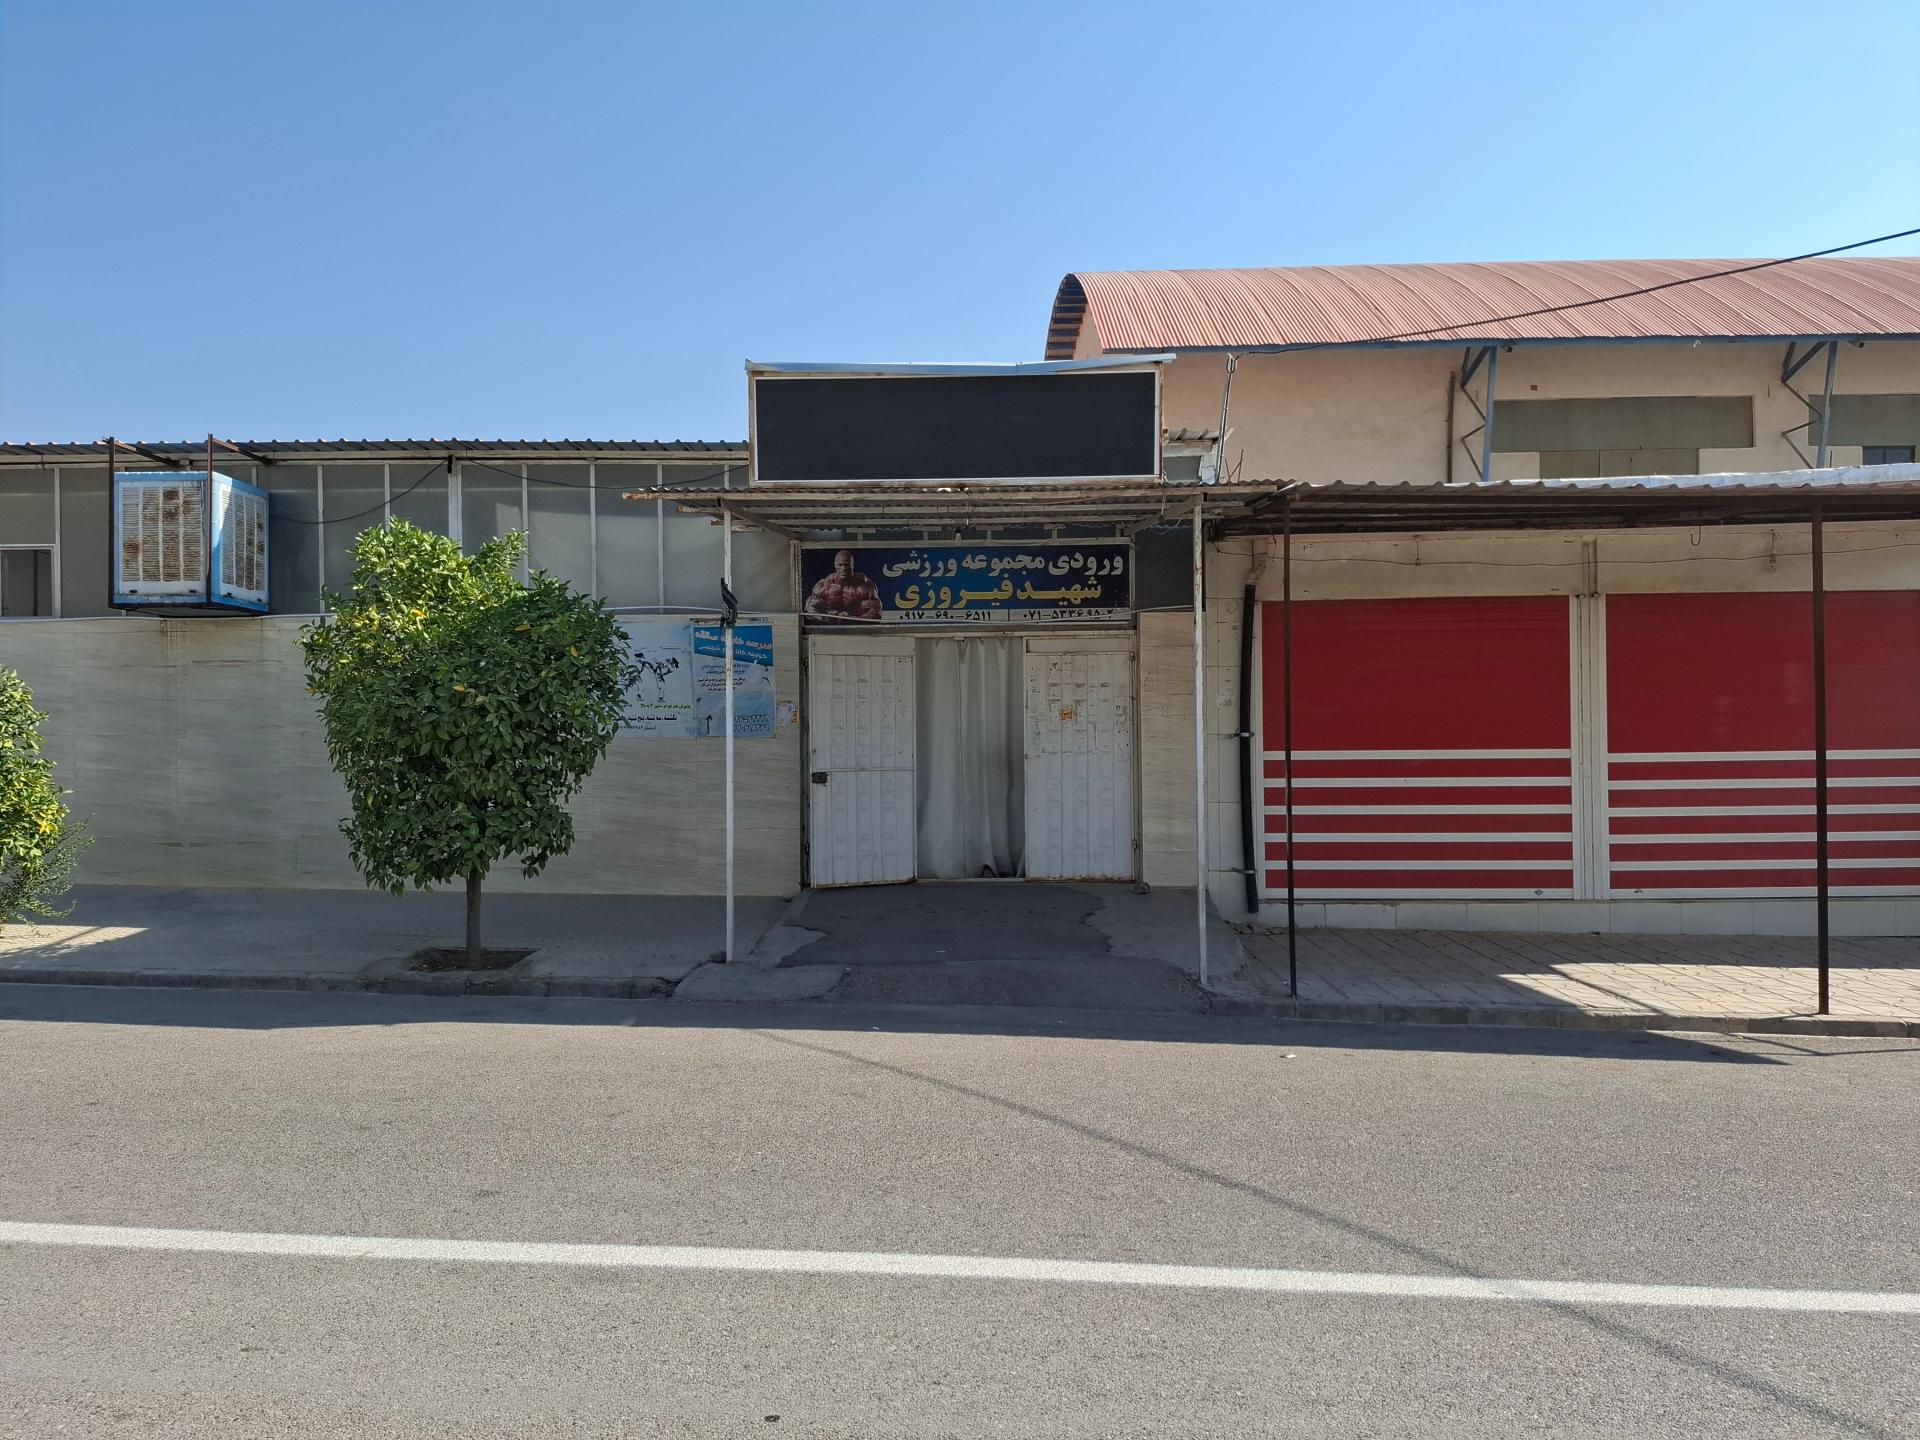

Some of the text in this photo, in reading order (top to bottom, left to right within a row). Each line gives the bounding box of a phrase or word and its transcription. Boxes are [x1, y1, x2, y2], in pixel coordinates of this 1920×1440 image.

[882, 550, 1124, 577] ورودی مجموعه ورزشی
[894, 573, 1102, 608] شهید فیروزی
